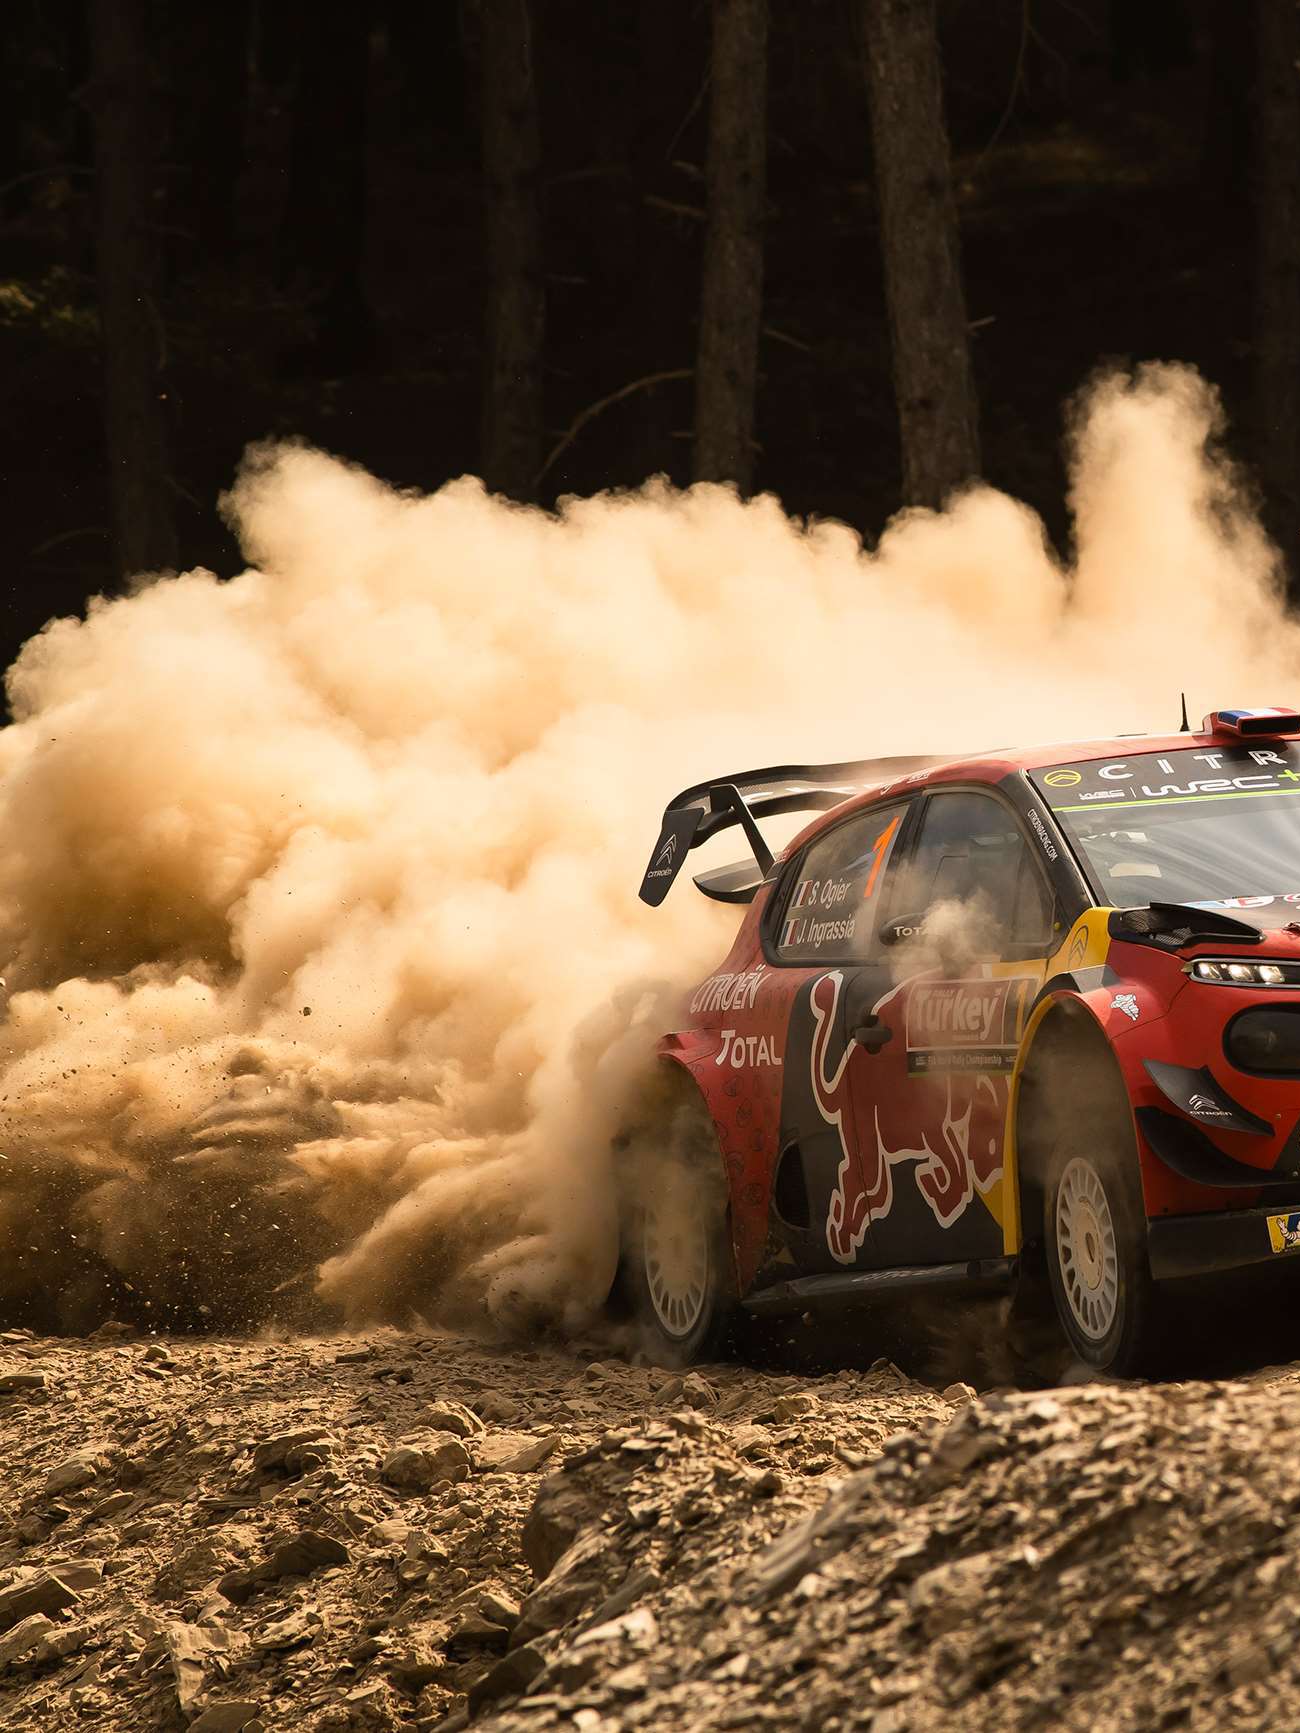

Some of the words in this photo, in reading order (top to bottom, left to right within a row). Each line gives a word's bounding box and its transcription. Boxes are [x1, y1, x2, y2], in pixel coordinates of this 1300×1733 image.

[864, 816, 901, 898] 1
[808, 881, 820, 905] S.
[820, 878, 852, 909] Ogier
[797, 918, 808, 944] J.
[807, 913, 857, 948] Ingrassia
[894, 926, 932, 937] TOTA
[915, 988, 1002, 1041] Turkey
[715, 1029, 782, 1068] TOTAL
